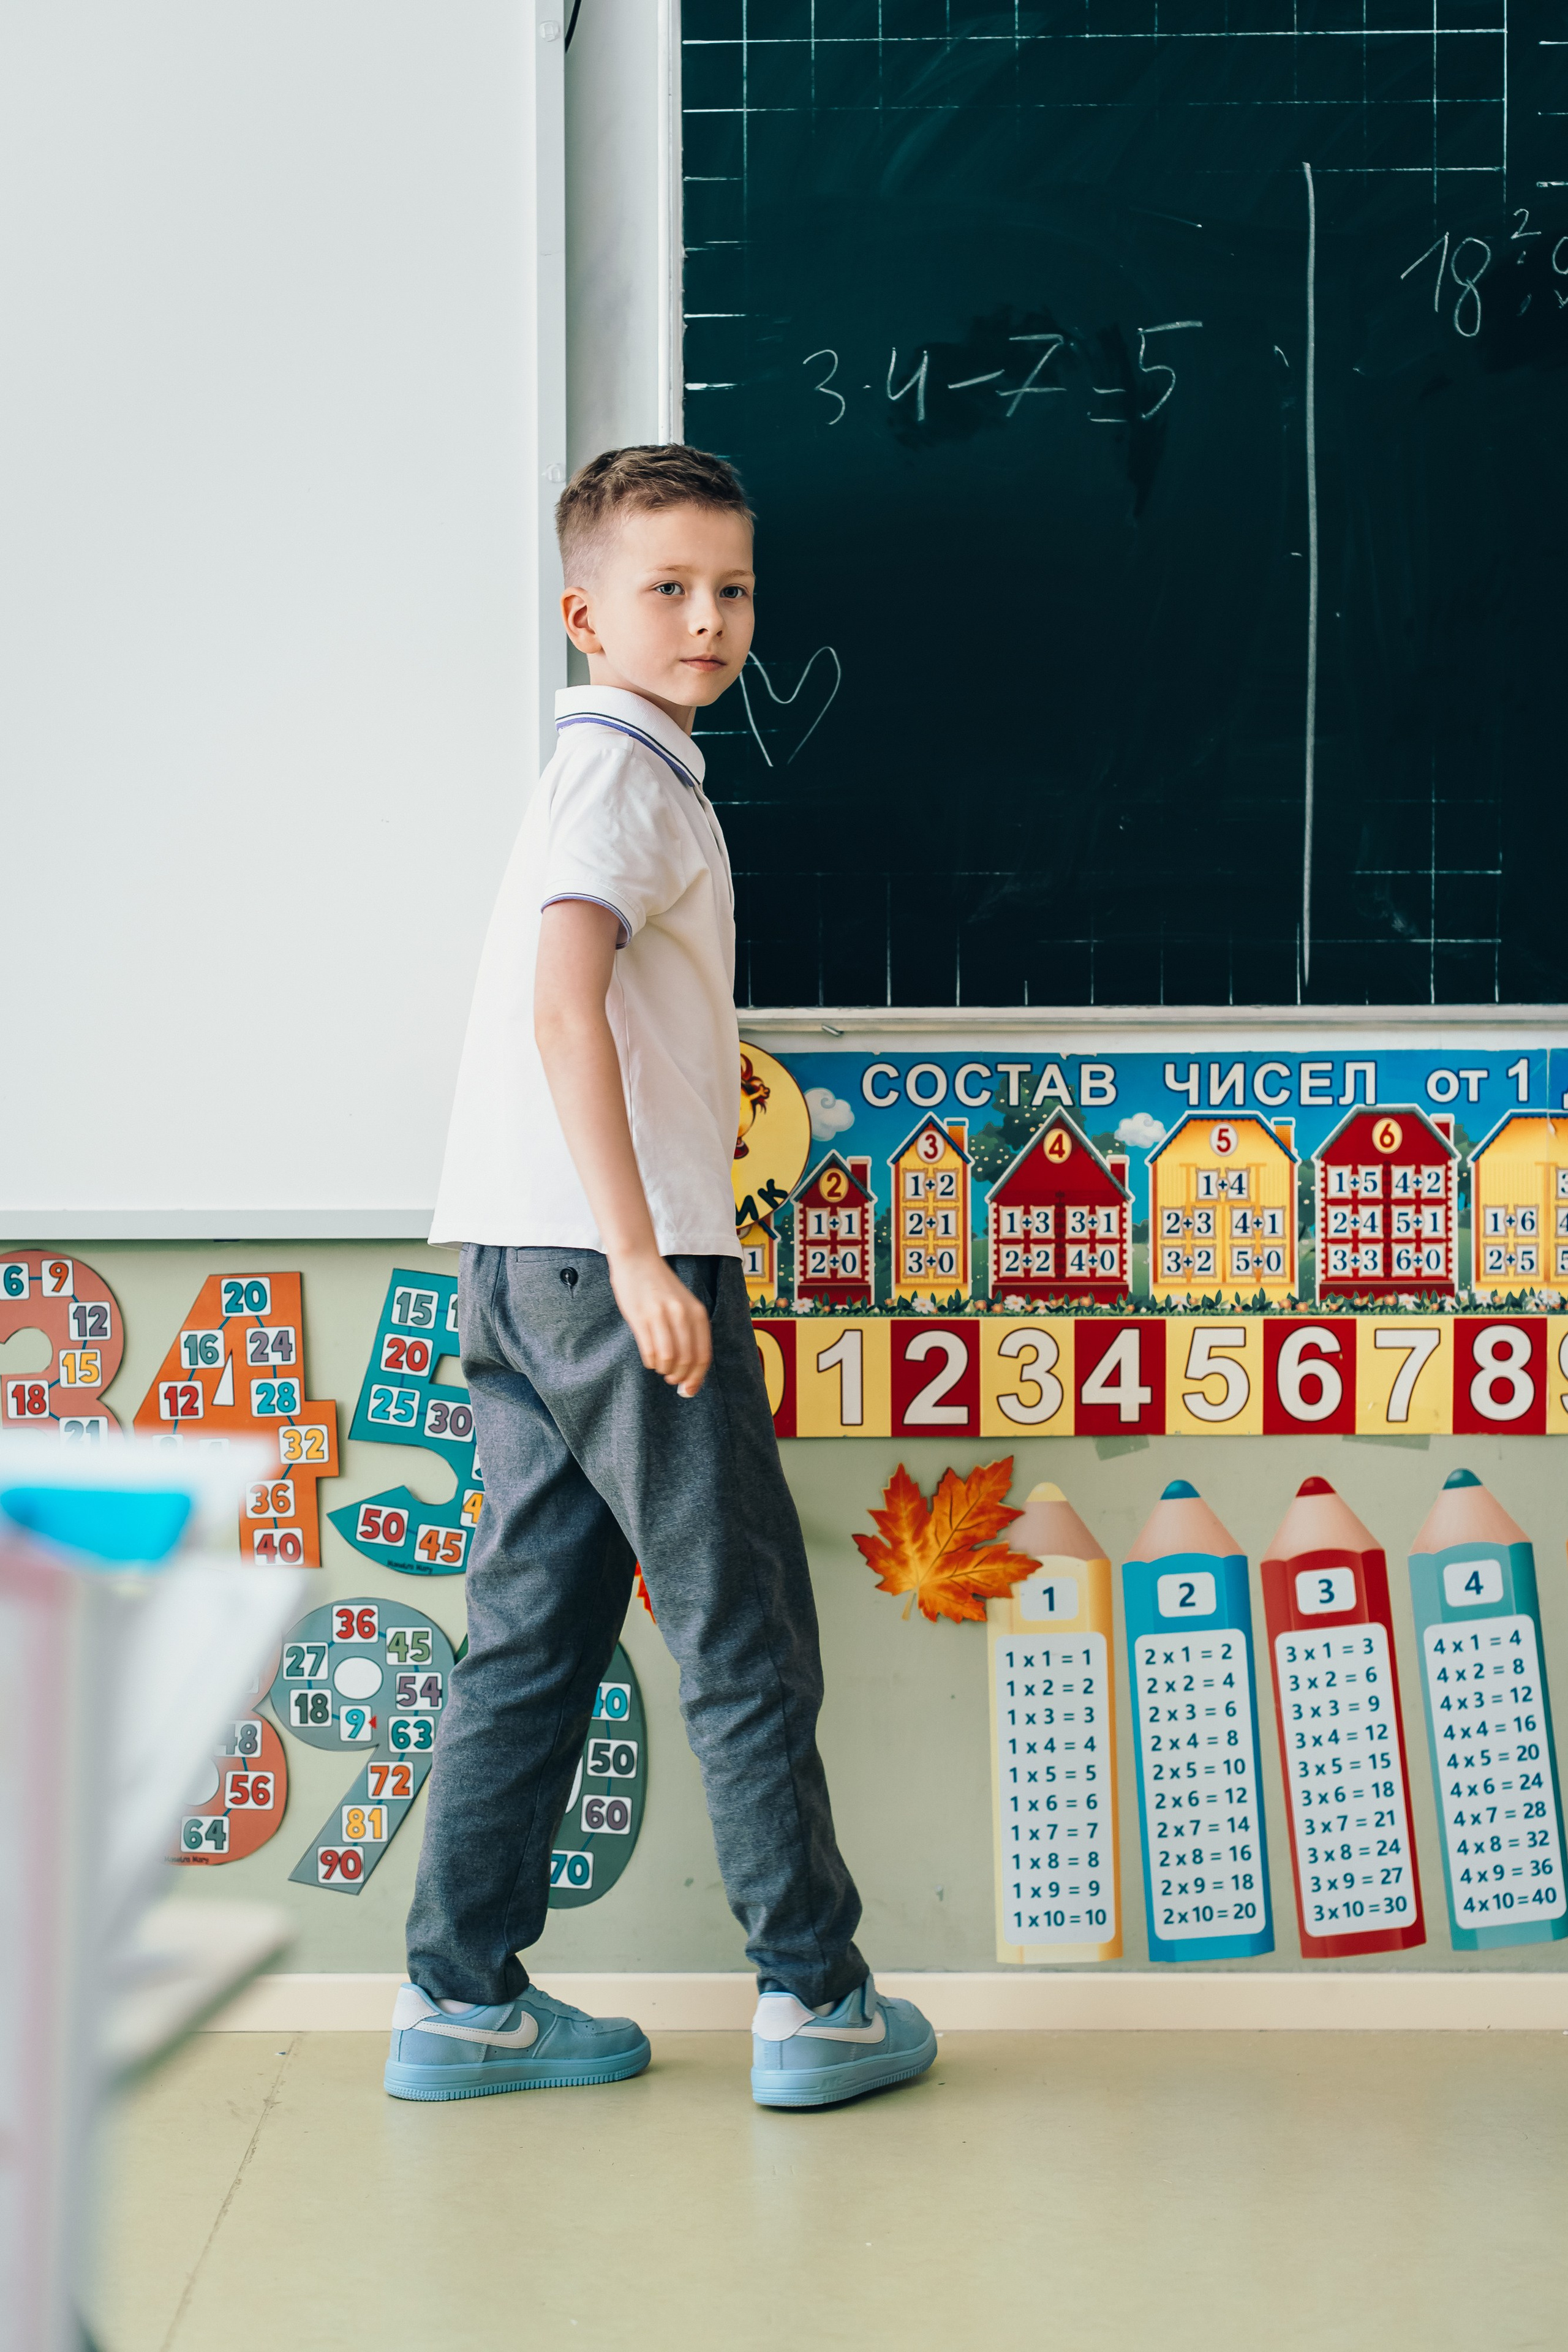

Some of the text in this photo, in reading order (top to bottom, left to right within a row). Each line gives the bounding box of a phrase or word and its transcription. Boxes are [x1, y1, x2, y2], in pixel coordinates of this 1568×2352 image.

[861, 1062, 1118, 1108] СОСТАВ
[1163, 1061, 1378, 1107] ЧИСЕЛ
[1425, 1069, 1489, 1103] от
[1507, 1058, 1529, 1102] 1
[924, 1133, 938, 1159] 3
[1048, 1133, 1066, 1159] 4
[1216, 1127, 1232, 1153] 5
[1379, 1122, 1395, 1148] 6
[826, 1172, 842, 1197] 2
[3, 1265, 24, 1297] 6
[49, 1262, 69, 1293] 9
[224, 1281, 268, 1313] 20
[396, 1290, 433, 1326] 15
[73, 1305, 108, 1337] 12
[184, 1333, 219, 1366] 16
[249, 1330, 293, 1363] 24
[385, 1338, 429, 1371] 20
[62, 1352, 100, 1384] 15
[816, 1329, 863, 1426] 1
[903, 1330, 970, 1425] 2
[997, 1327, 1064, 1425] 3
[1081, 1328, 1153, 1423] 4
[1183, 1326, 1251, 1422] 5
[1276, 1325, 1343, 1422] 6
[1374, 1327, 1441, 1423] 7
[1469, 1324, 1535, 1422] 8
[12, 1384, 47, 1415] 18
[164, 1385, 200, 1417] 12
[255, 1381, 297, 1414] 28
[371, 1388, 416, 1423] 25
[429, 1402, 473, 1438] 30
[283, 1428, 325, 1461] 32
[249, 1482, 292, 1515] 36
[360, 1507, 405, 1542] 50
[256, 1532, 301, 1564] 40
[418, 1530, 463, 1563] 45
[1042, 1586, 1054, 1611] 1
[1178, 1582, 1196, 1608] 2
[1318, 1578, 1335, 1605] 3
[1464, 1571, 1485, 1597] 4
[335, 1608, 376, 1639] 36
[285, 1646, 326, 1677] 27
[388, 1630, 430, 1663] 45
[294, 1692, 330, 1724] 18
[398, 1676, 442, 1708] 54
[345, 1709, 361, 1739] 9
[391, 1719, 433, 1751] 63
[590, 1743, 635, 1775] 50
[228, 1774, 271, 1806] 56
[370, 1765, 411, 1796] 72
[346, 1807, 384, 1839] 81
[586, 1798, 628, 1831] 60
[183, 1819, 227, 1850] 64
[320, 1849, 363, 1880] 90
[550, 1853, 590, 1886] 70
